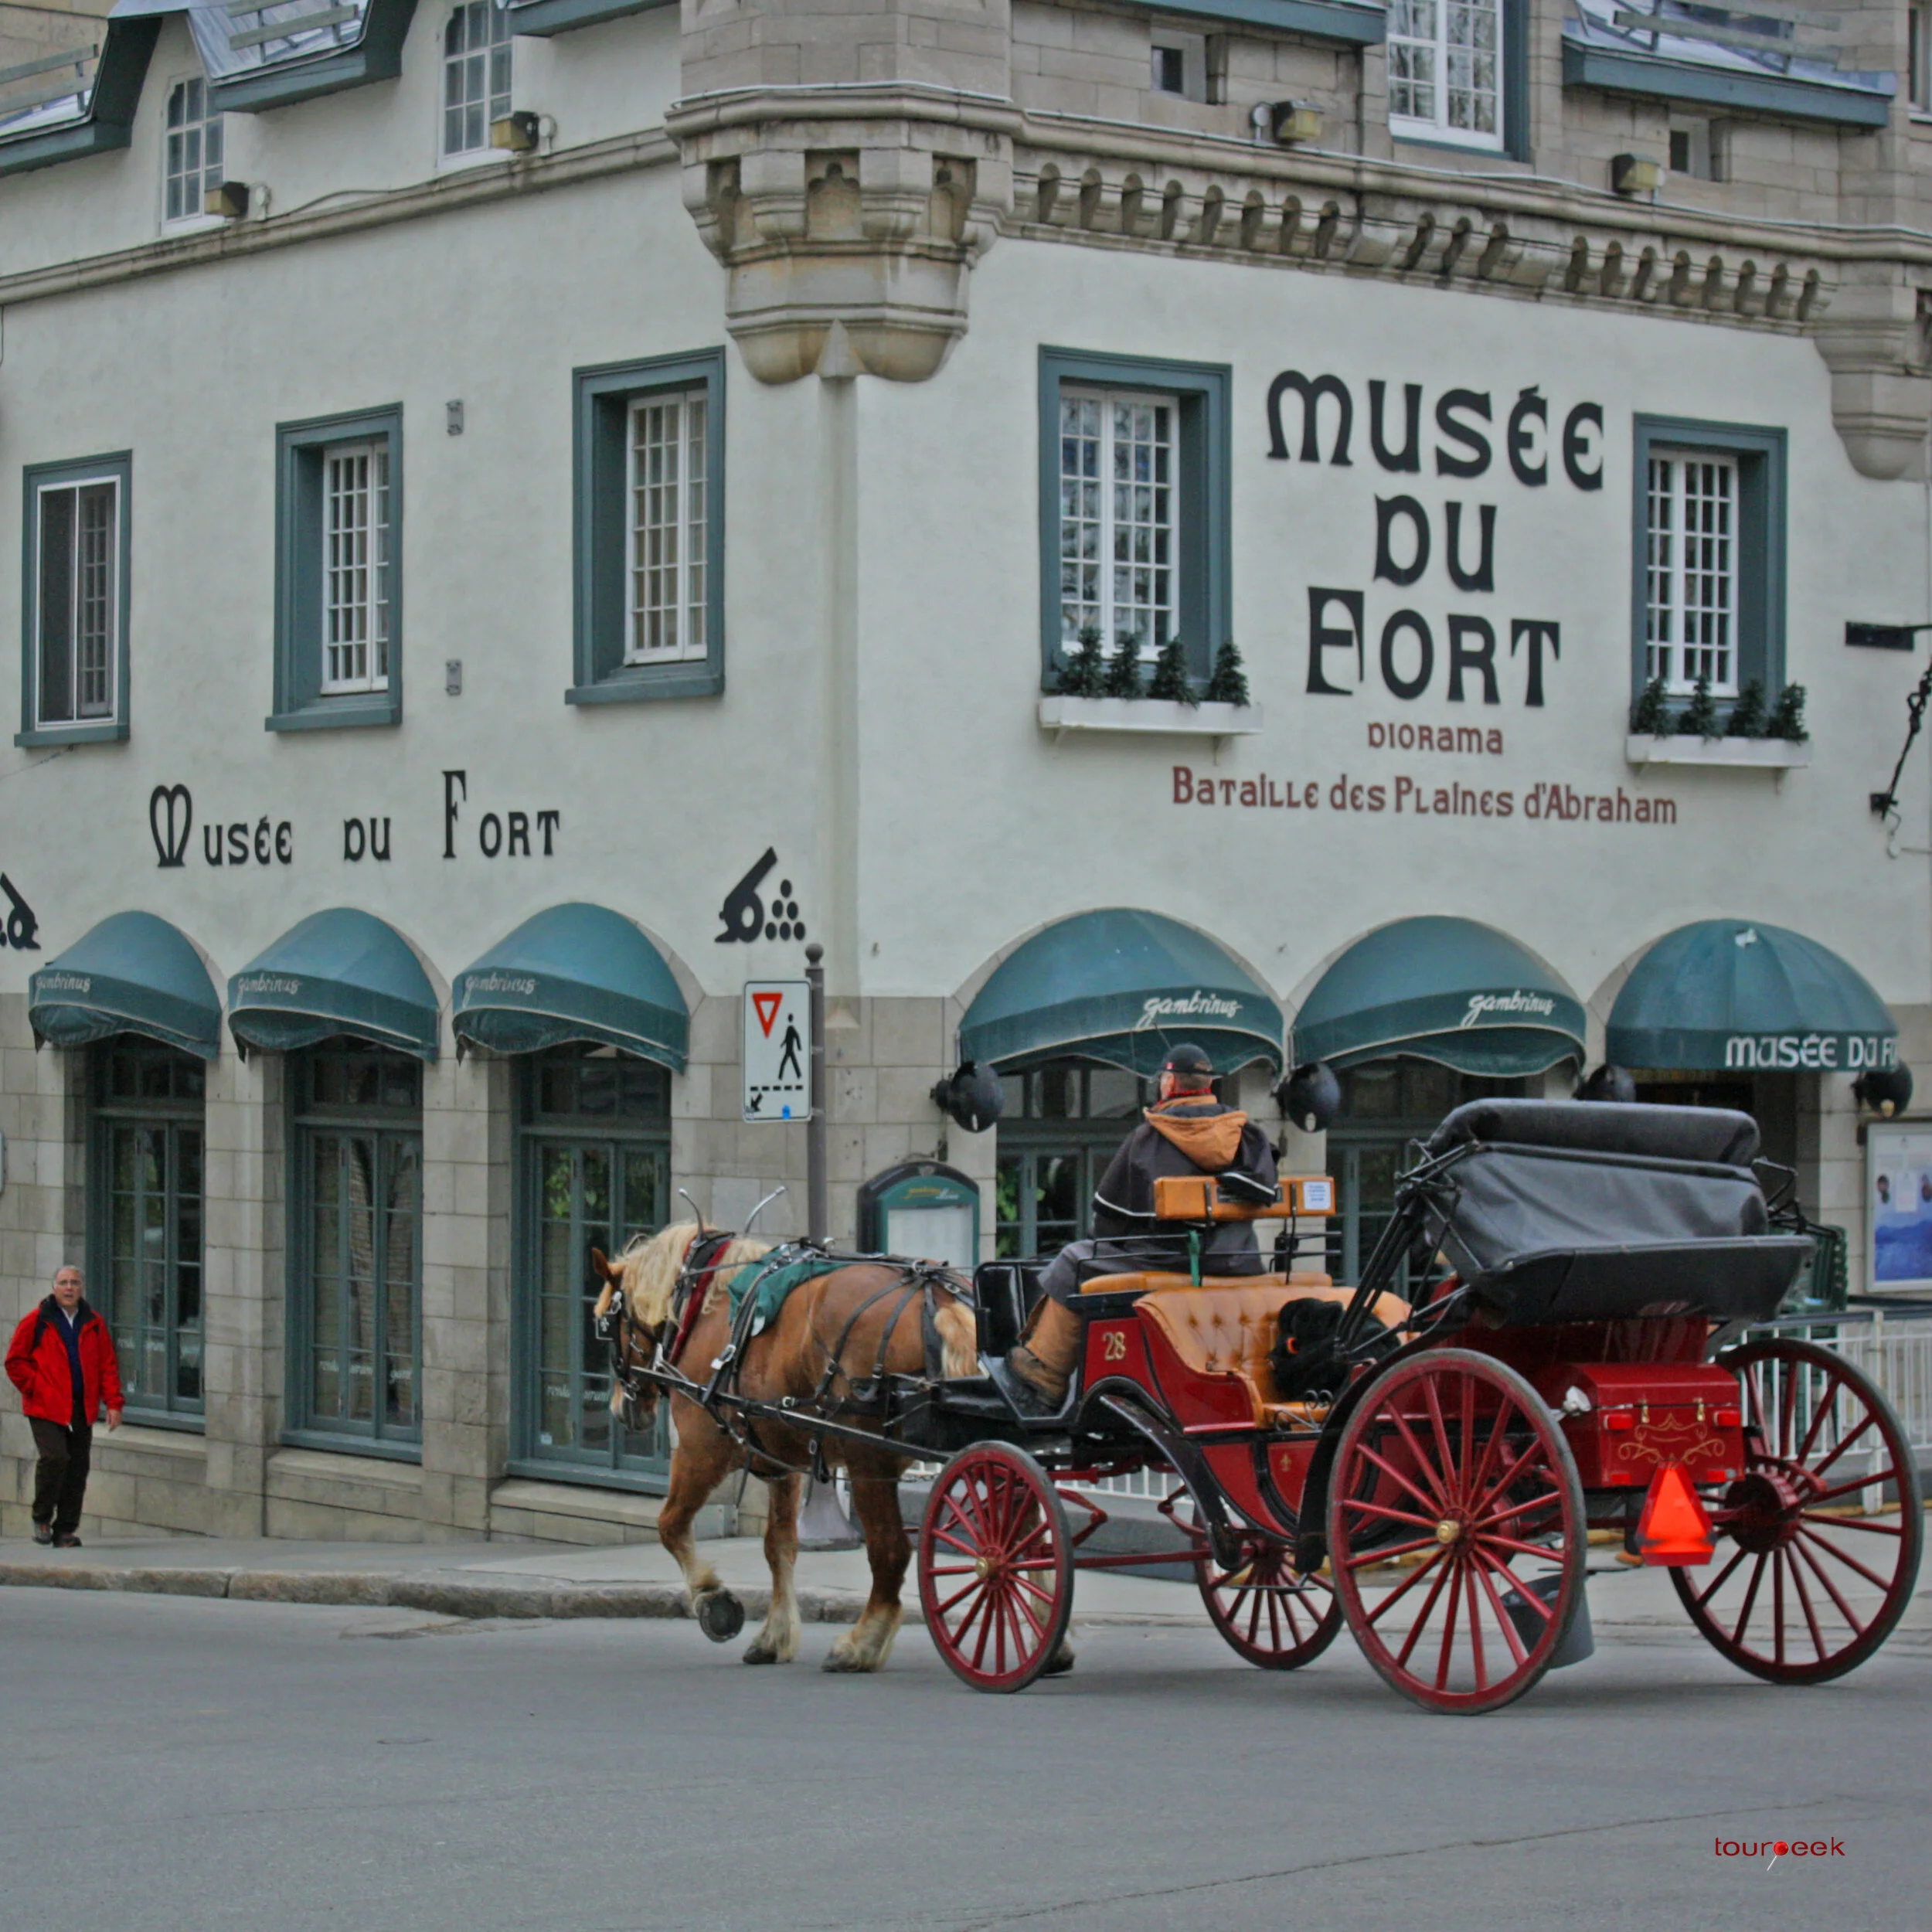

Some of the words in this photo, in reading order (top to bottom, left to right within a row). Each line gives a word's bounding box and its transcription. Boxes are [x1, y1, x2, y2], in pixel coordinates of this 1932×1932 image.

[1267, 369, 1604, 492] MUSÉE
[1372, 494, 1498, 593] DU
[1305, 586, 1561, 708] FORT
[1330, 773, 1387, 812] des
[1394, 775, 1514, 818] Plaines
[1523, 782, 1678, 825] d'Abraham
[1724, 1032, 1838, 1068] MUSÉE
[1847, 1036, 1878, 1068] DU
[1101, 1331, 1127, 1361] 28
